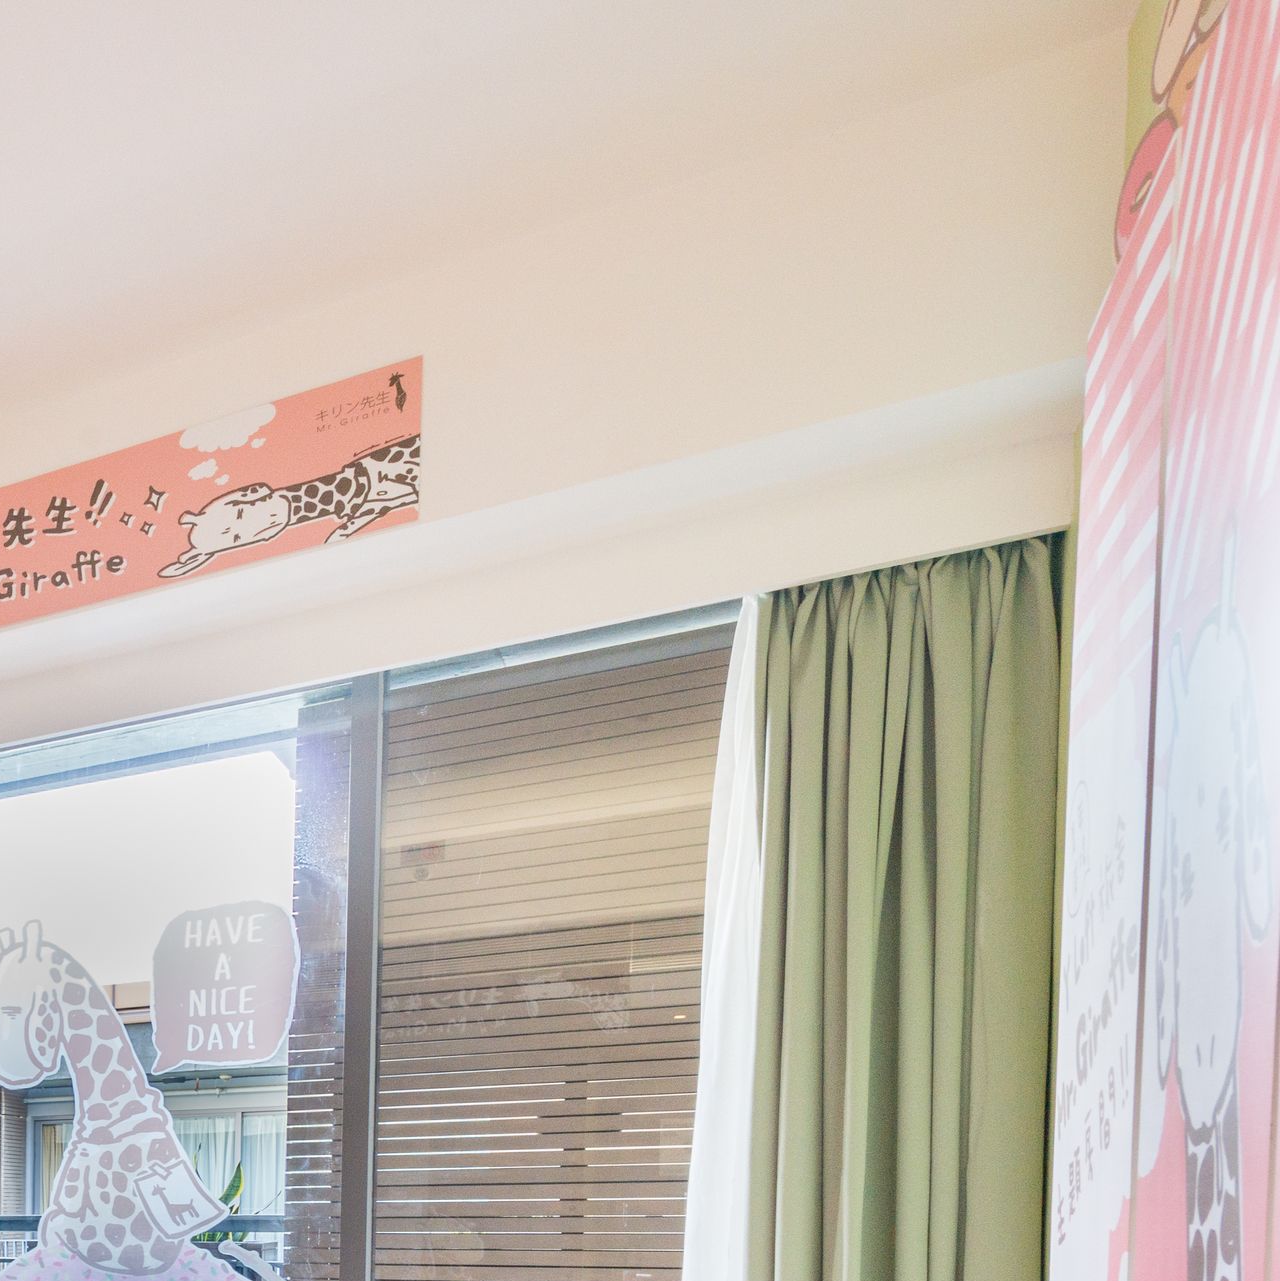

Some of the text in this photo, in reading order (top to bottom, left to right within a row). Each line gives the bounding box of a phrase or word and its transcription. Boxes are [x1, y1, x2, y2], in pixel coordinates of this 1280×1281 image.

[315, 391, 391, 422] キリン先生
[186, 914, 264, 948] HAVE
[214, 953, 231, 981] A
[188, 985, 256, 1017] NICE
[186, 1020, 256, 1053] DAY!
